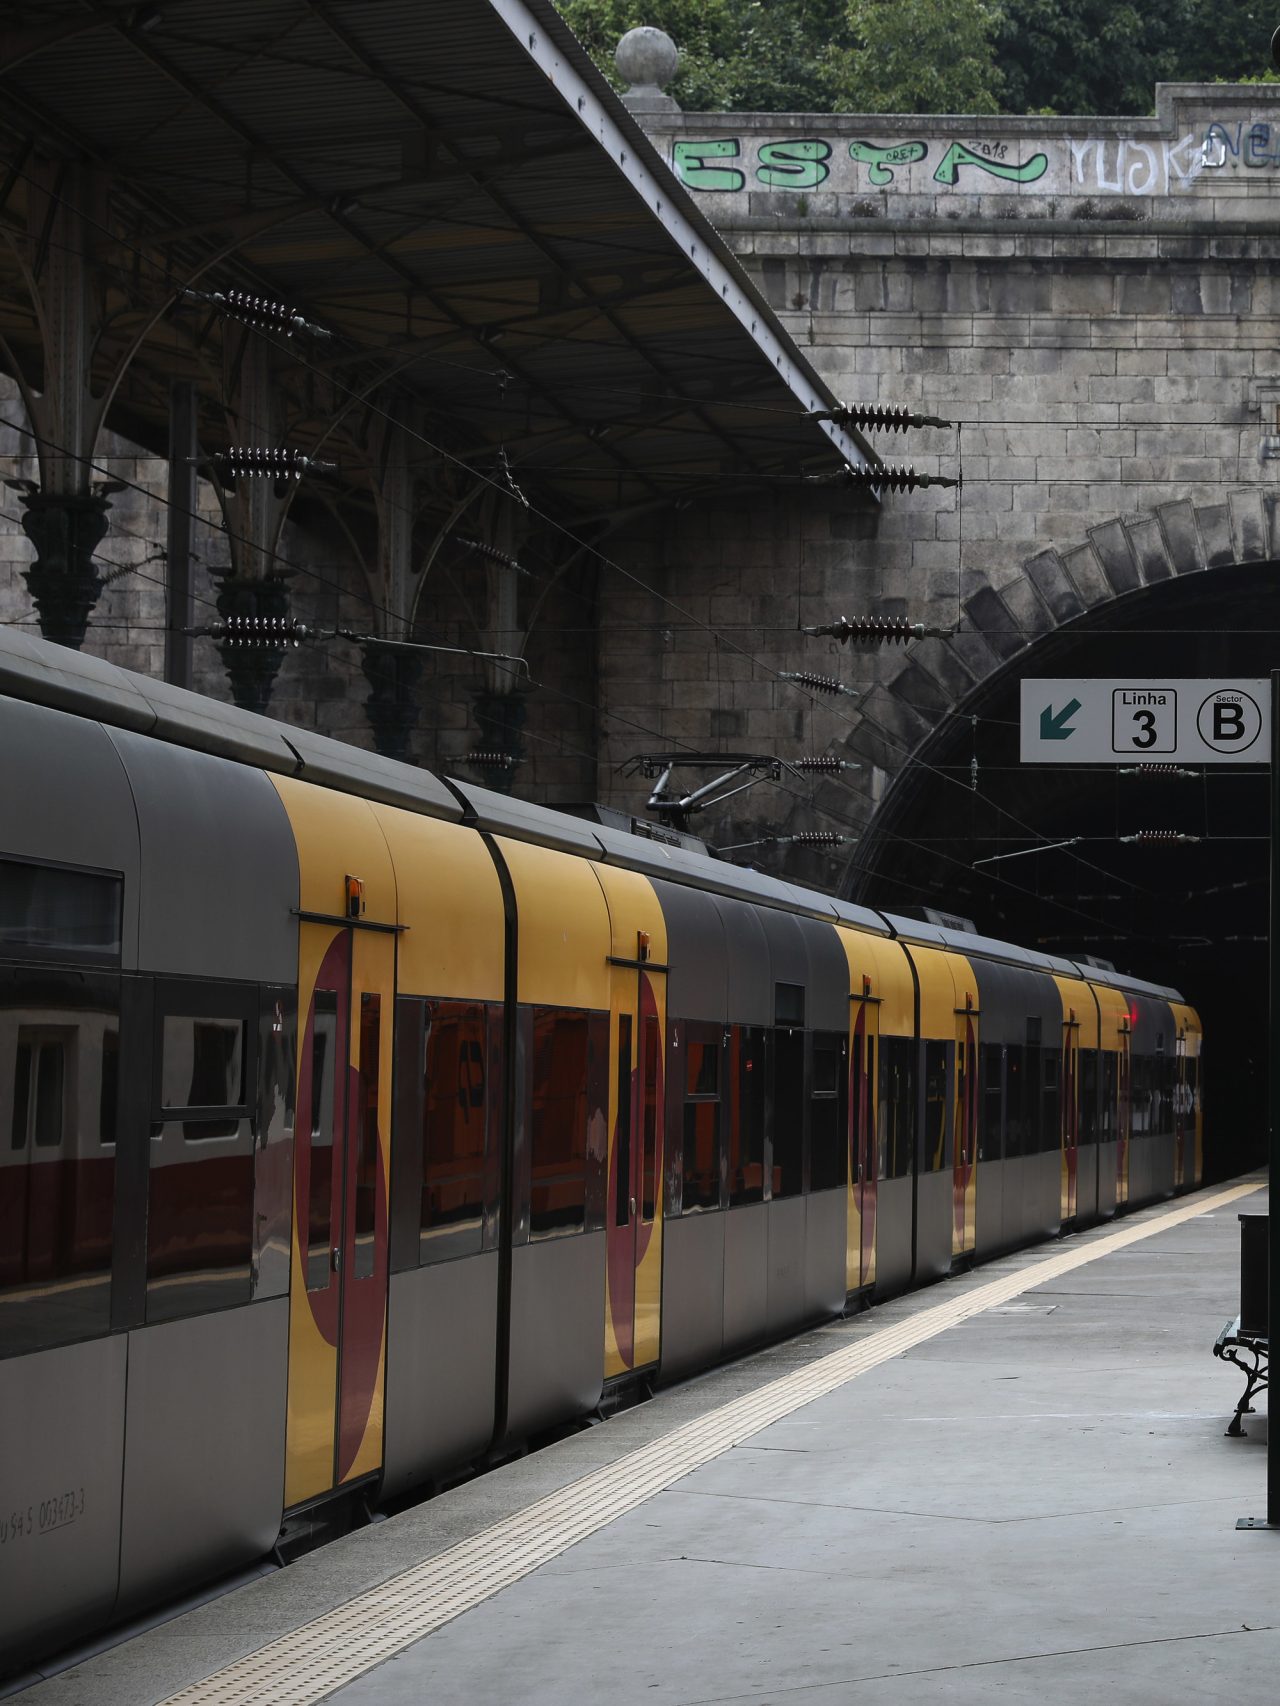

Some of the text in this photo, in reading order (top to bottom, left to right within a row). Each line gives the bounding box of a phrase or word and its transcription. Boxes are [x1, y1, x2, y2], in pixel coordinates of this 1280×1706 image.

[1122, 692, 1167, 706] Linha
[1216, 694, 1244, 704] Sector
[1132, 709, 1158, 749] 3
[1213, 702, 1246, 741] B
